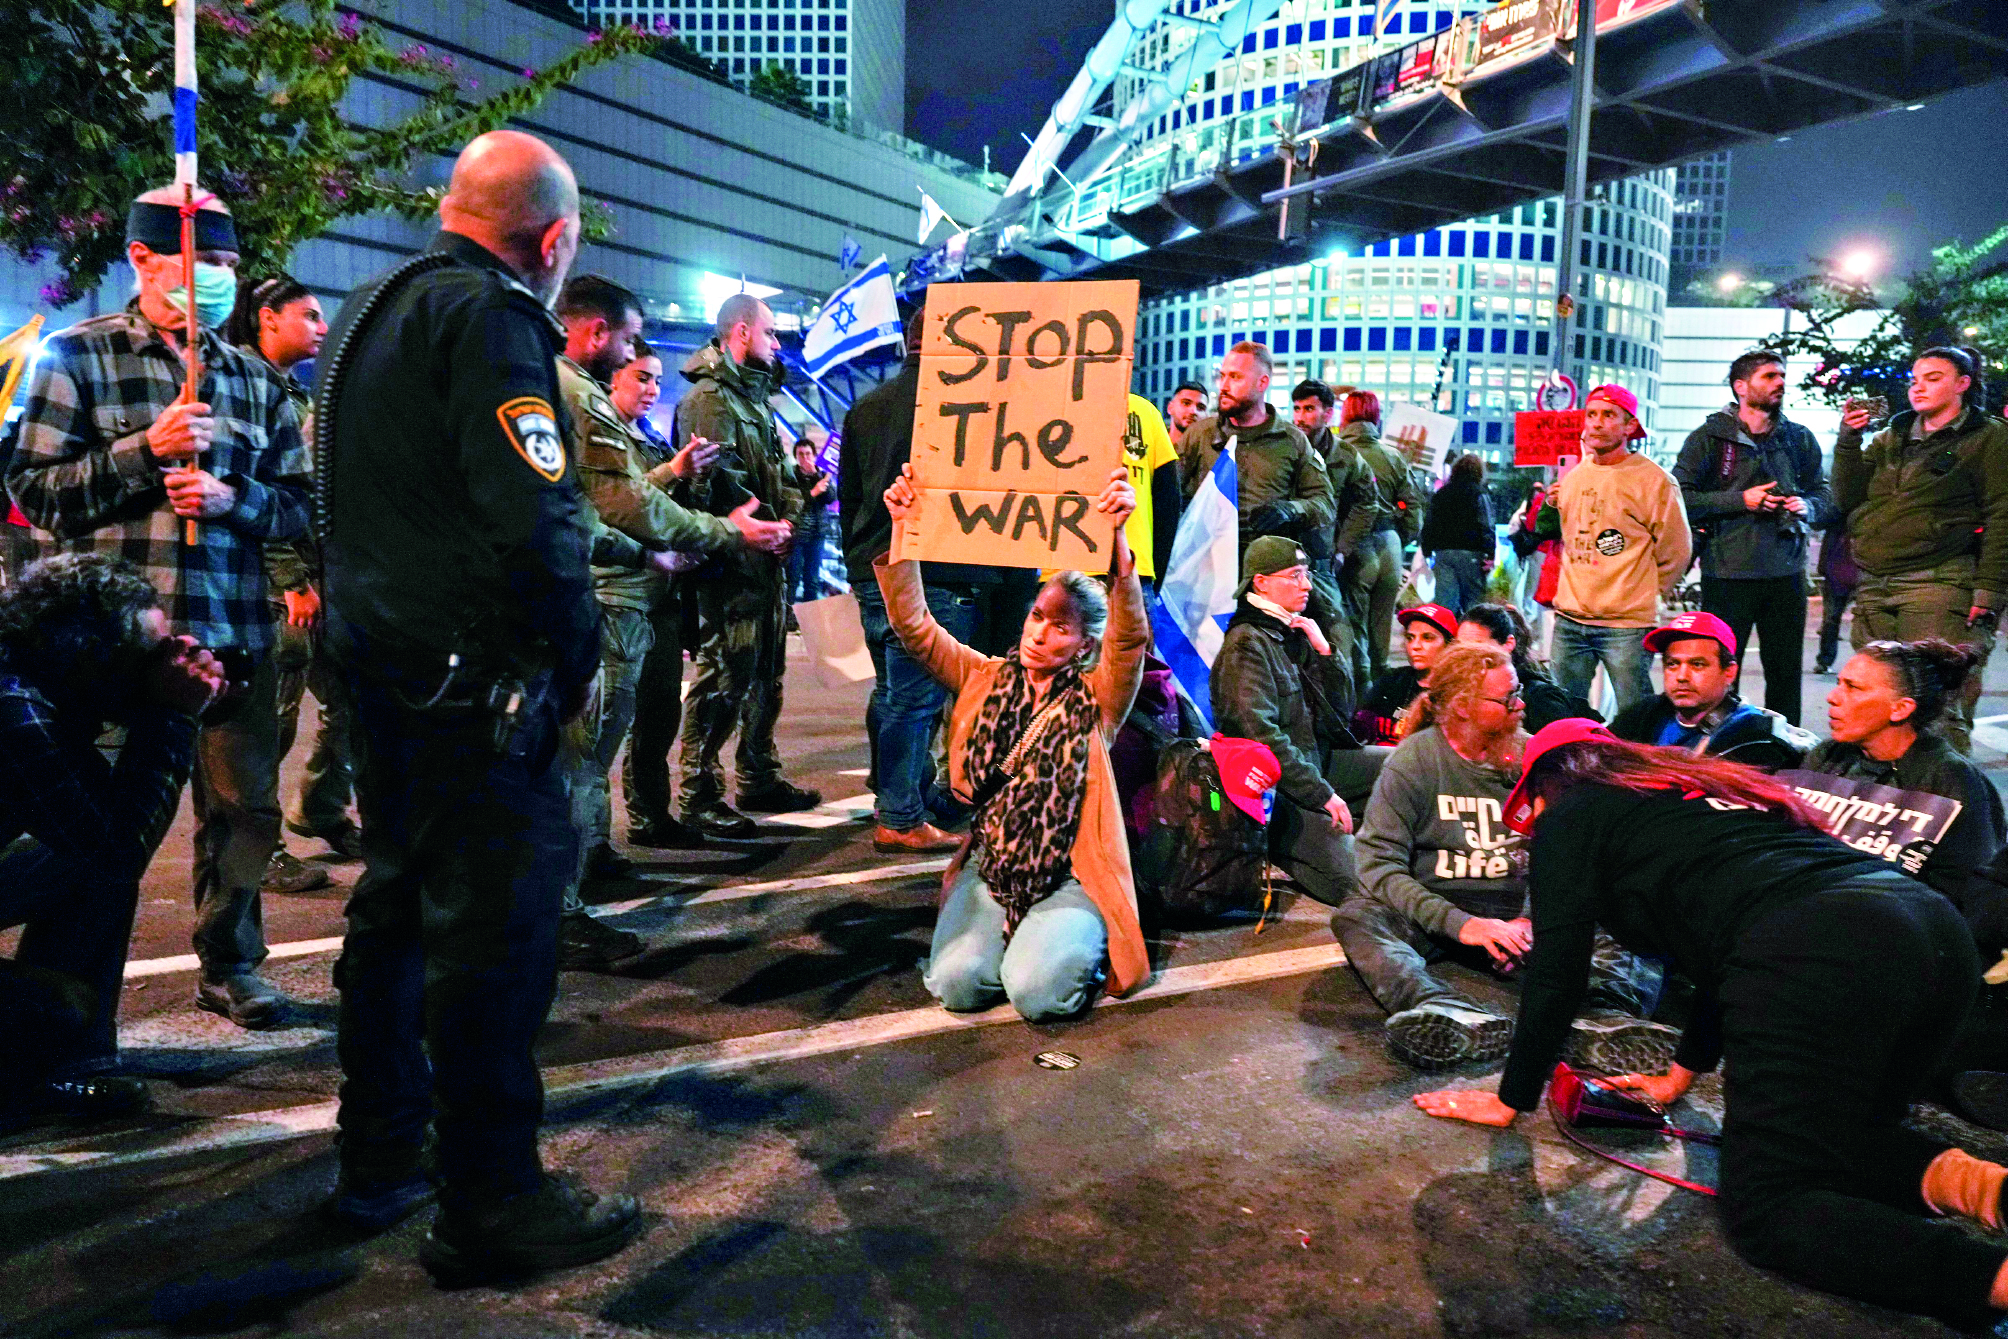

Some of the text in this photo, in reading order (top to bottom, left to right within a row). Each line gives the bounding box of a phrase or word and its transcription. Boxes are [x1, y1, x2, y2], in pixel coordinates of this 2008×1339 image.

[937, 305, 1123, 401] STOP
[938, 402, 1089, 472] The
[949, 489, 1098, 553] WAR
[1898, 809, 1934, 833] די
[1435, 849, 1509, 879] Life
